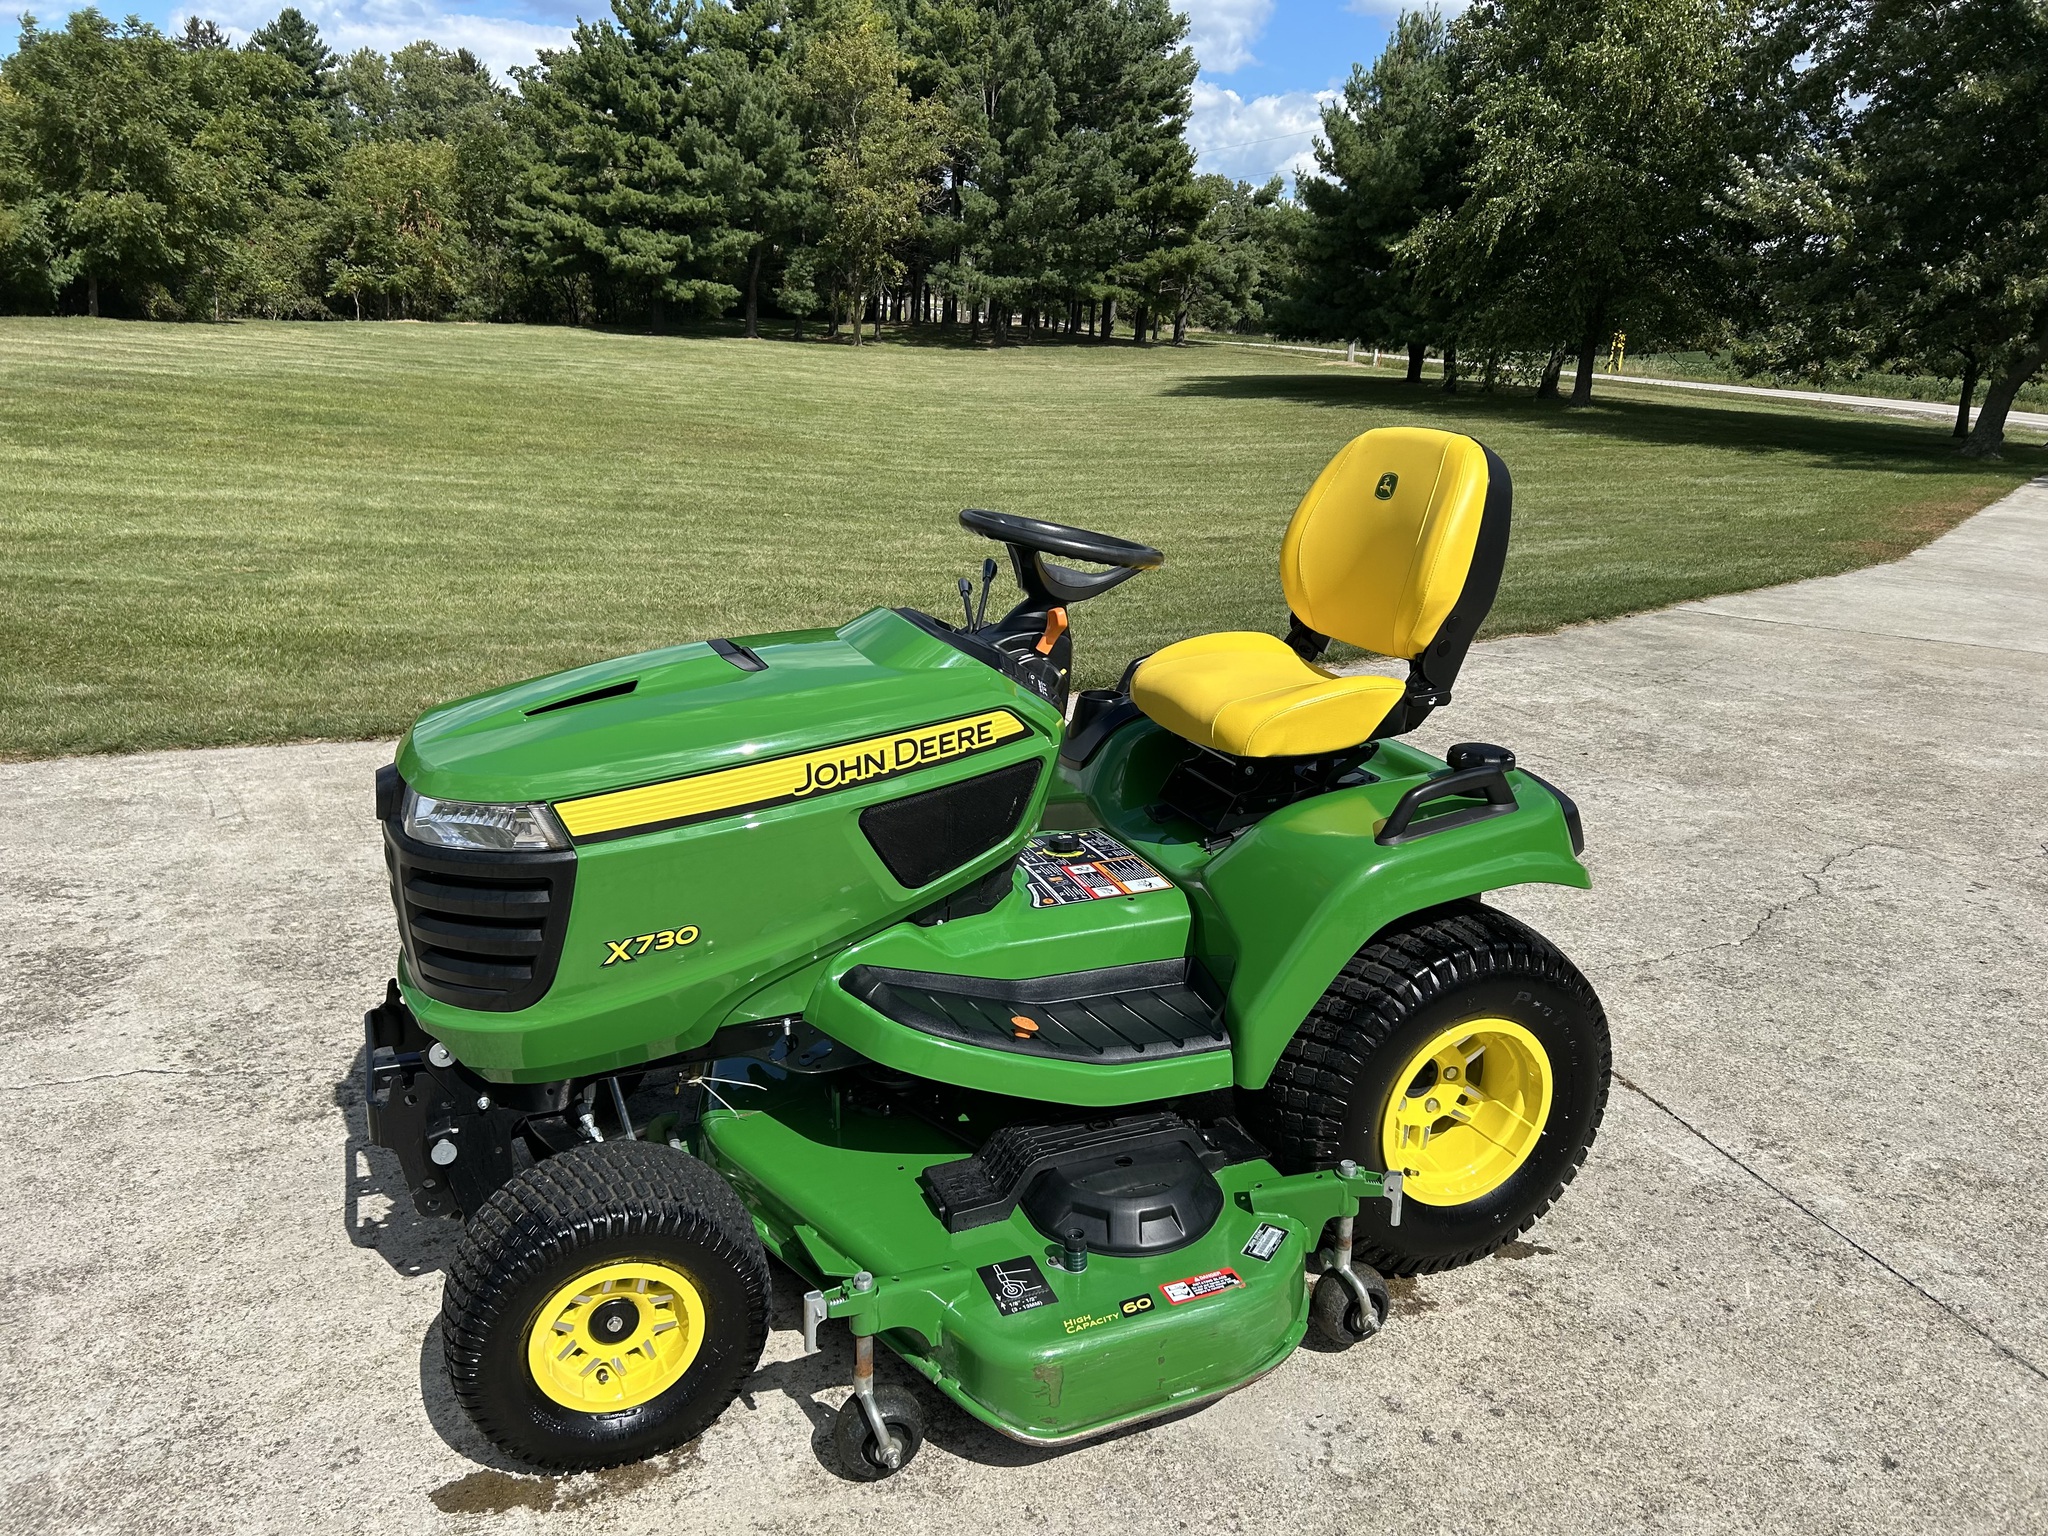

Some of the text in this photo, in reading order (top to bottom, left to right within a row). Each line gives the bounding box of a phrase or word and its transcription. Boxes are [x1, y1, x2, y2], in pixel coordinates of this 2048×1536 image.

[794, 720, 993, 793] JOHN DEERE
[601, 924, 700, 967] X730
[1198, 1270, 1222, 1280] DANGER
[1122, 1297, 1152, 1314] 60
[1063, 1314, 1091, 1328] HIGH
[1066, 1312, 1119, 1334] CAPACITY
